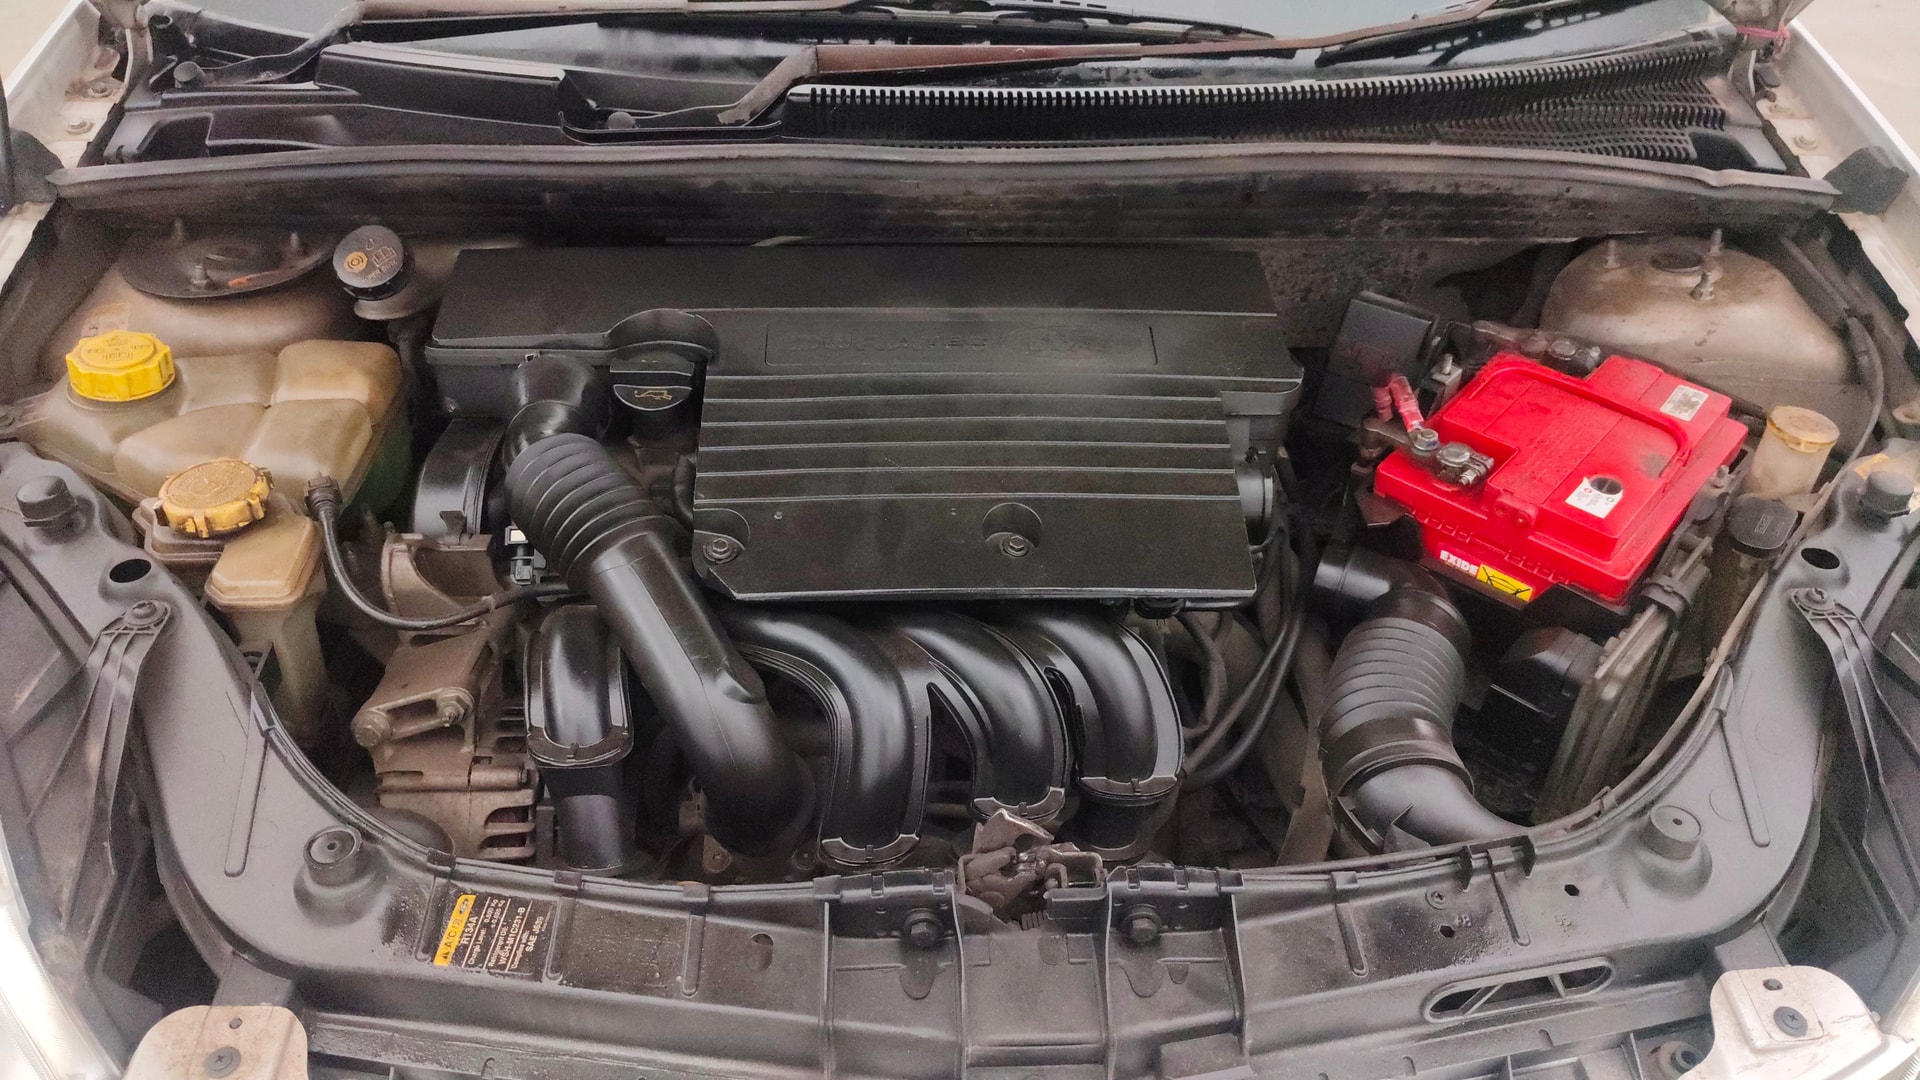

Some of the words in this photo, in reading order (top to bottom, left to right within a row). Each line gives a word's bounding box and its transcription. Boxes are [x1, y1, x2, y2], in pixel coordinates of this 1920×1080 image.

[1440, 550, 1479, 575] EXIDE
[461, 916, 478, 944] R134A
[526, 935, 538, 952] SAE
